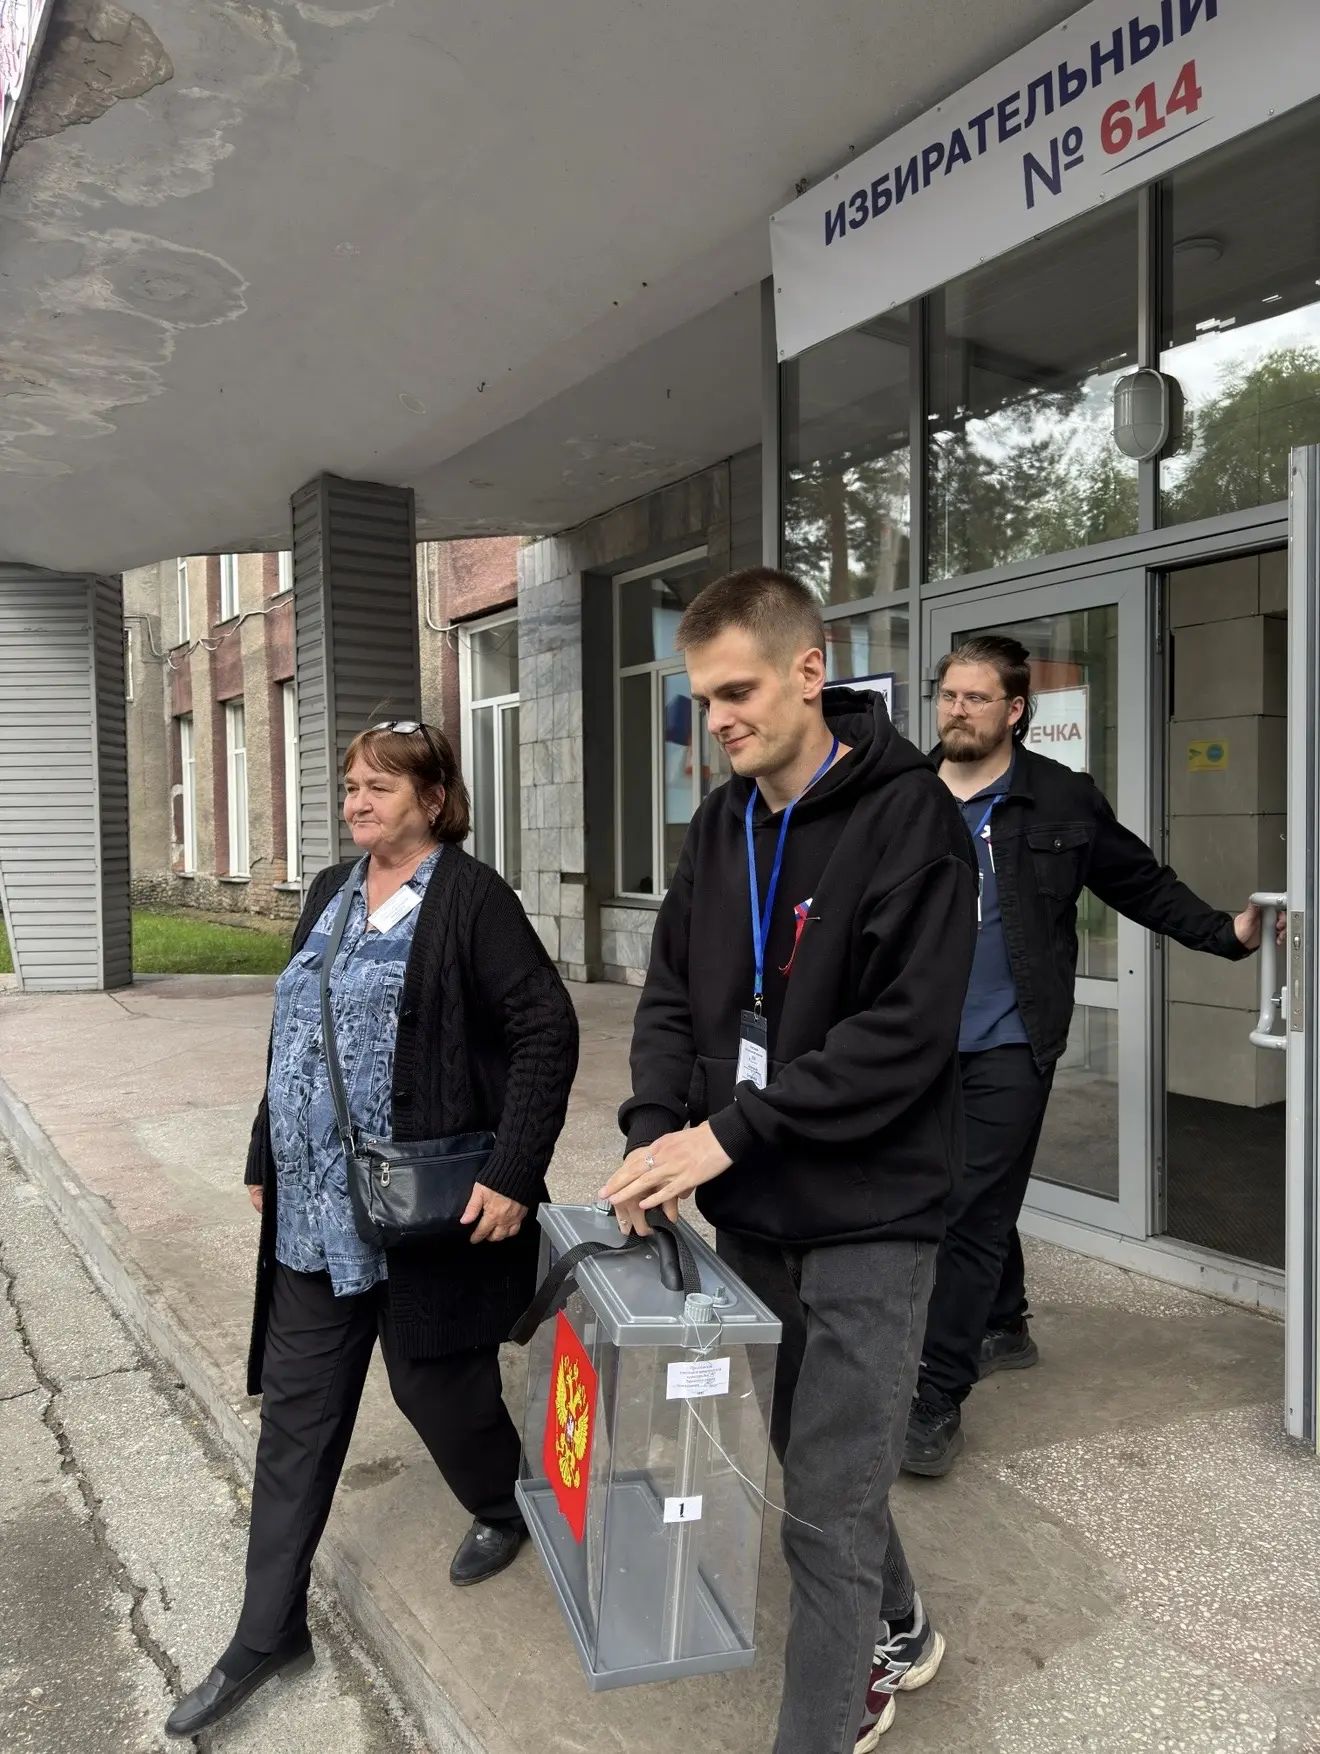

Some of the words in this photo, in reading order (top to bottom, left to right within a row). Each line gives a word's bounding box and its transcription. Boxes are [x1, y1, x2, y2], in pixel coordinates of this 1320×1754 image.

[1023, 126, 1084, 210] №
[1101, 59, 1202, 155] 614
[1030, 722, 1082, 743] ЕЧКА
[679, 1502, 685, 1518] 1
